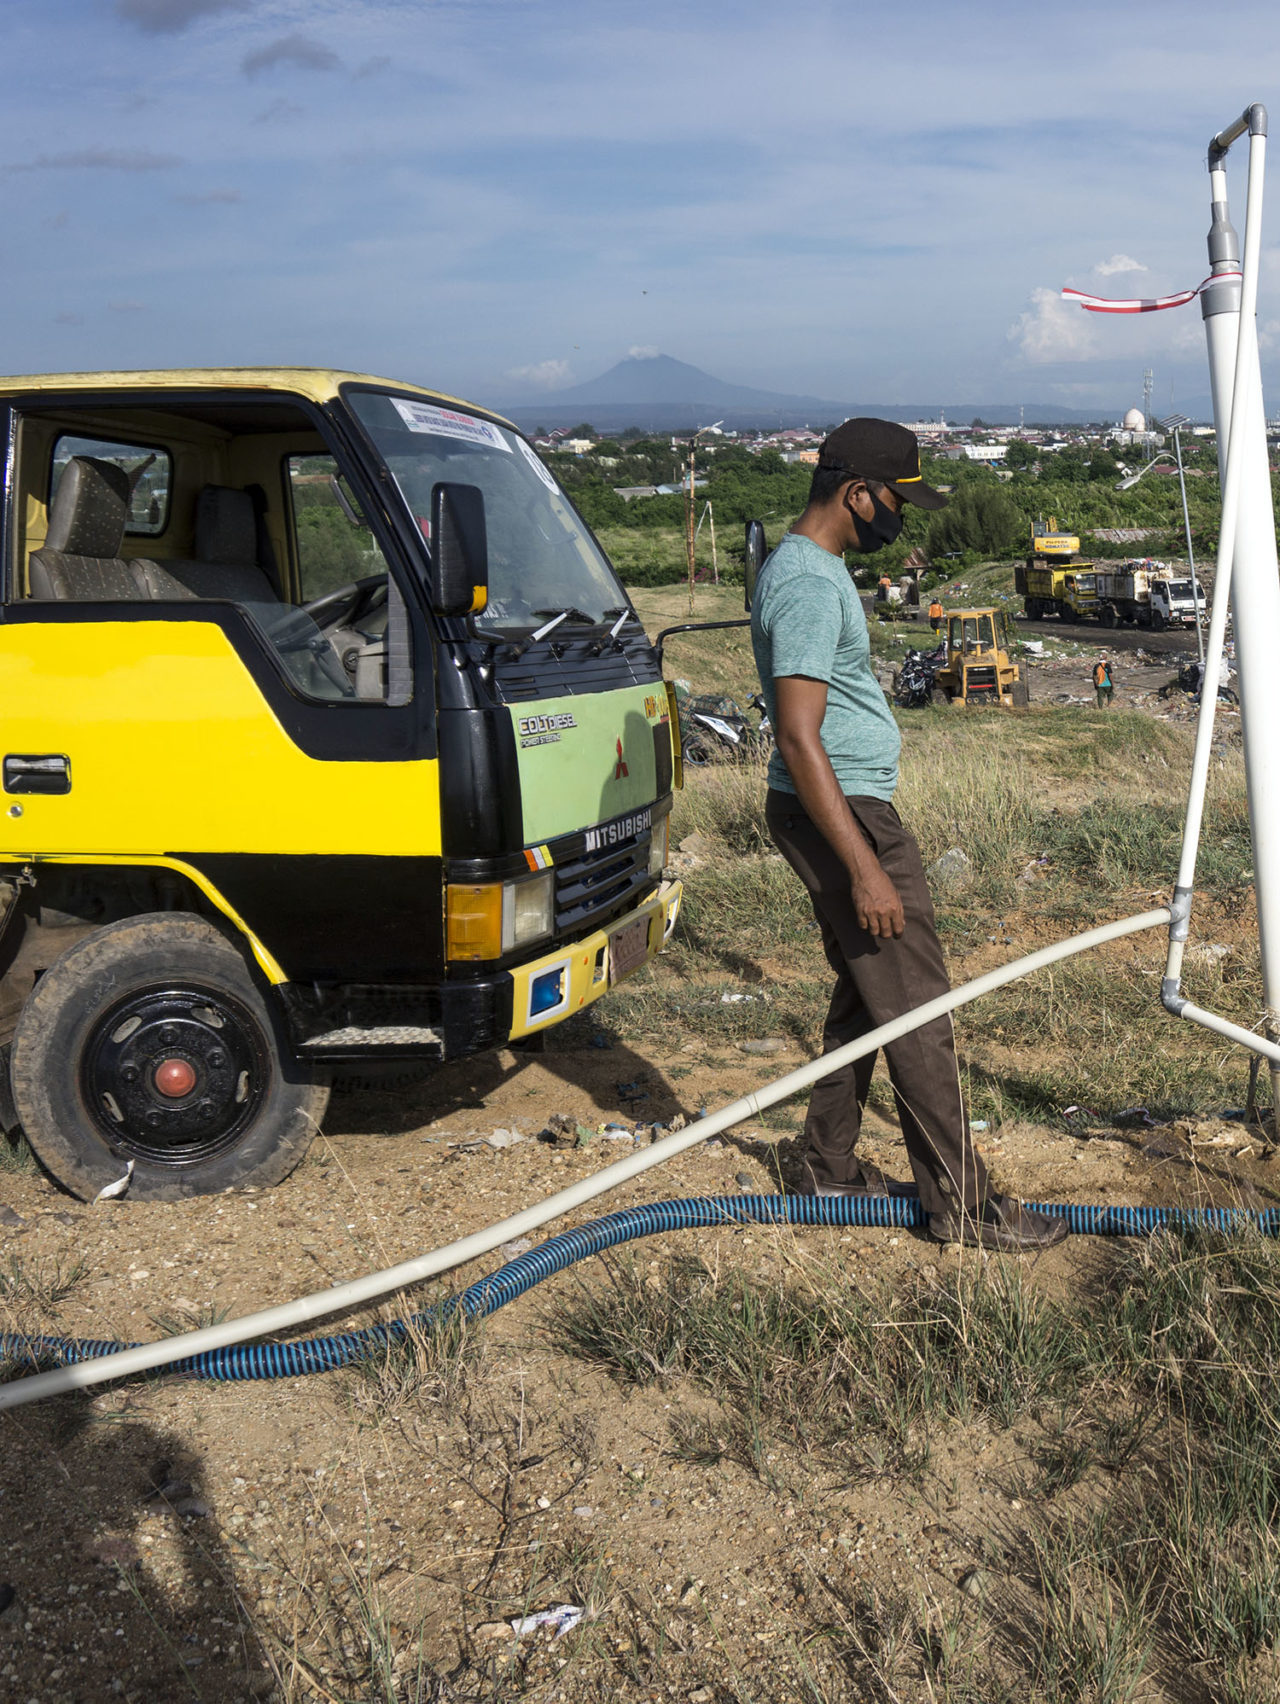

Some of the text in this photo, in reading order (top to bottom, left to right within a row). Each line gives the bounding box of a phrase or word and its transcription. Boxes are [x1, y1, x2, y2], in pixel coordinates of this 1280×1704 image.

[518, 713, 578, 737] COLT DIESEL
[585, 809, 652, 852] MITSUBISHI
